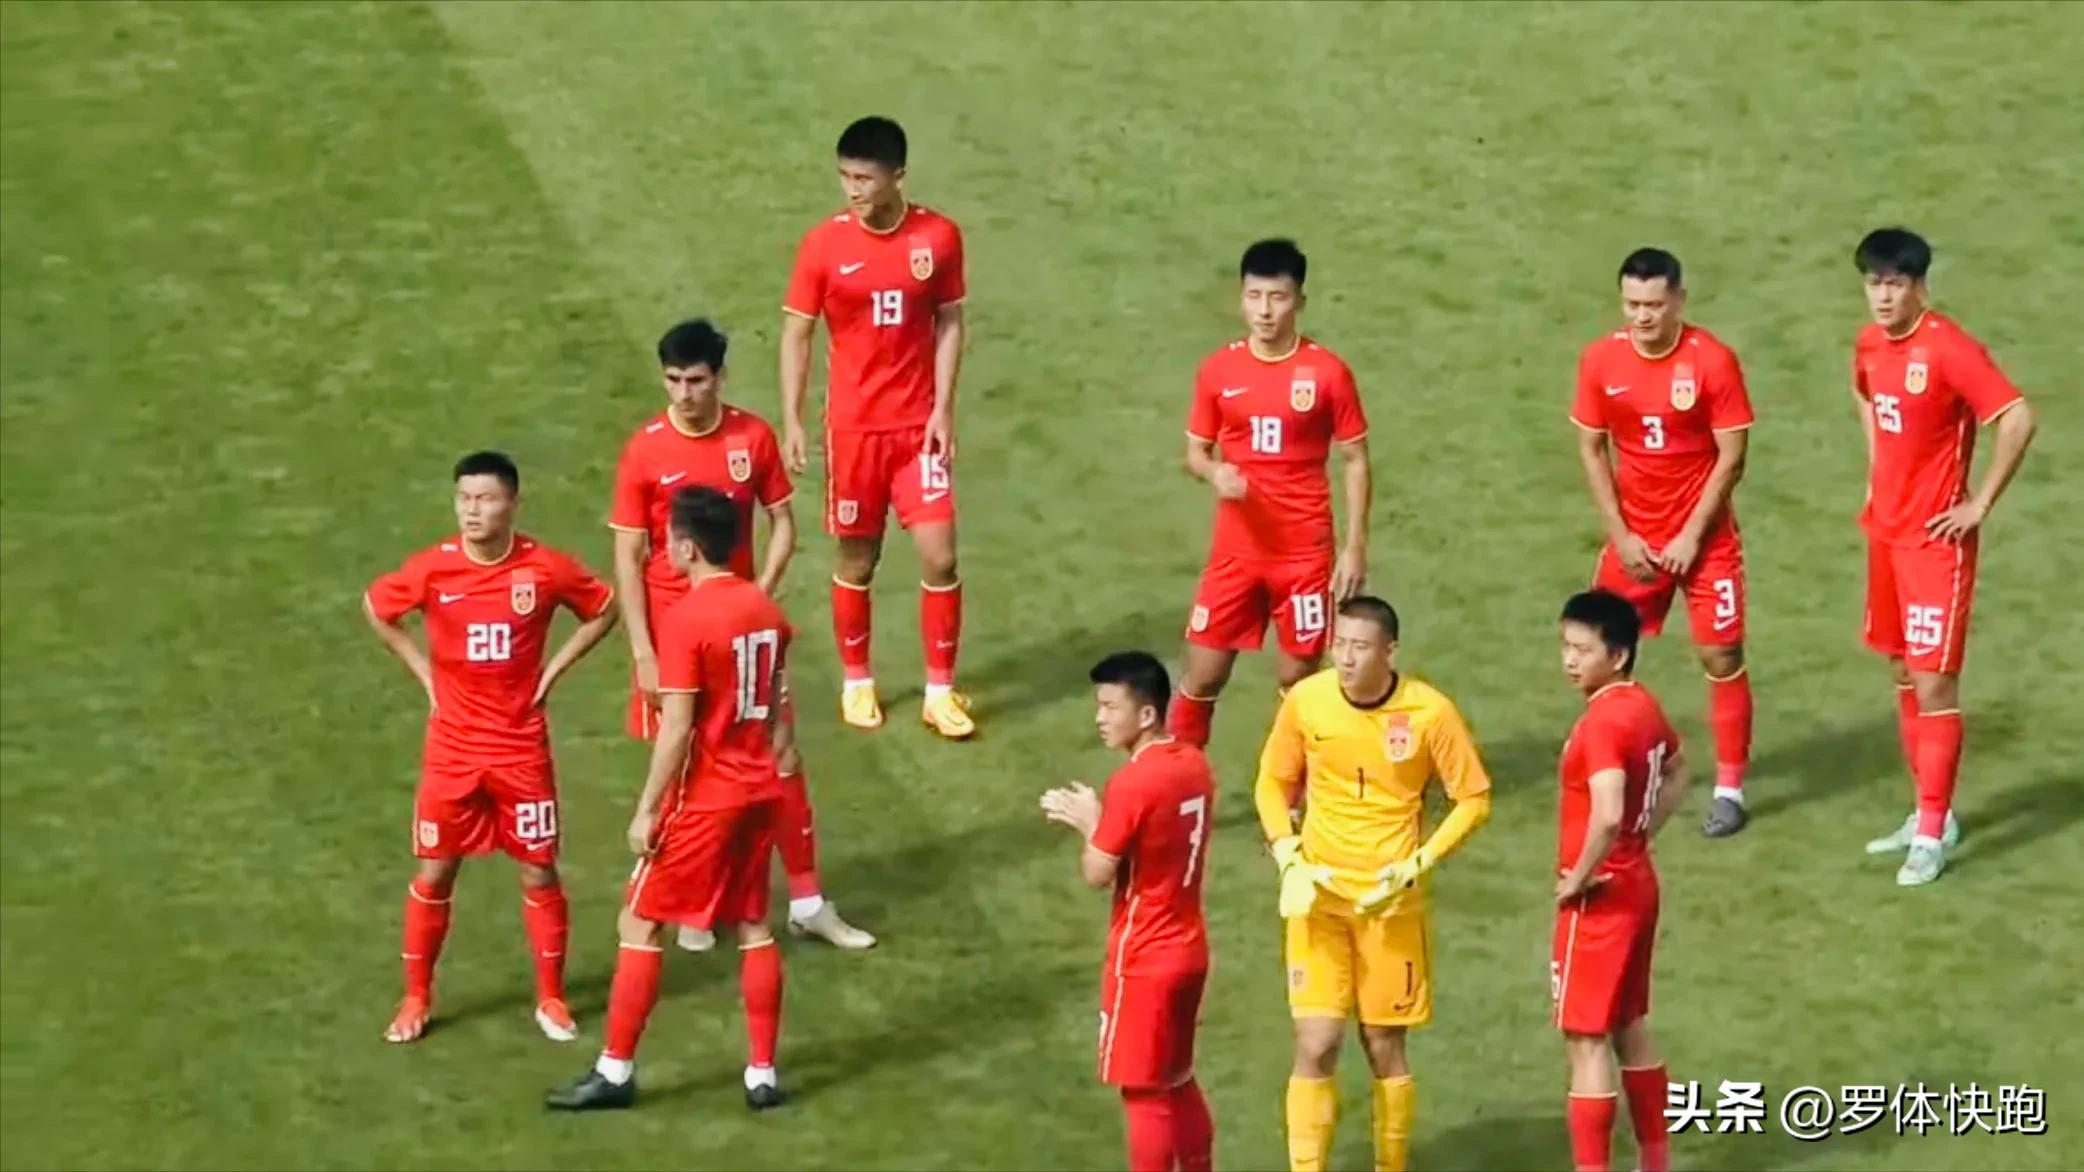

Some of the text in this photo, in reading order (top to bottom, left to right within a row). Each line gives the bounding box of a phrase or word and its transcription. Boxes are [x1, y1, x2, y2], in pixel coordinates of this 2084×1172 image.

[871, 289, 903, 327] 19
[1642, 415, 1665, 449] 3
[1874, 392, 1902, 434] 25
[1250, 415, 1282, 453] 18
[1291, 593, 1325, 631] 18
[1713, 578, 1737, 618] 3
[466, 623, 512, 661] 20
[1904, 604, 1944, 647] 25
[732, 629, 778, 722] 10
[1356, 766, 1366, 799] 1
[515, 800, 557, 840] 20
[1179, 795, 1206, 888] 7
[1405, 960, 1413, 997] 1
